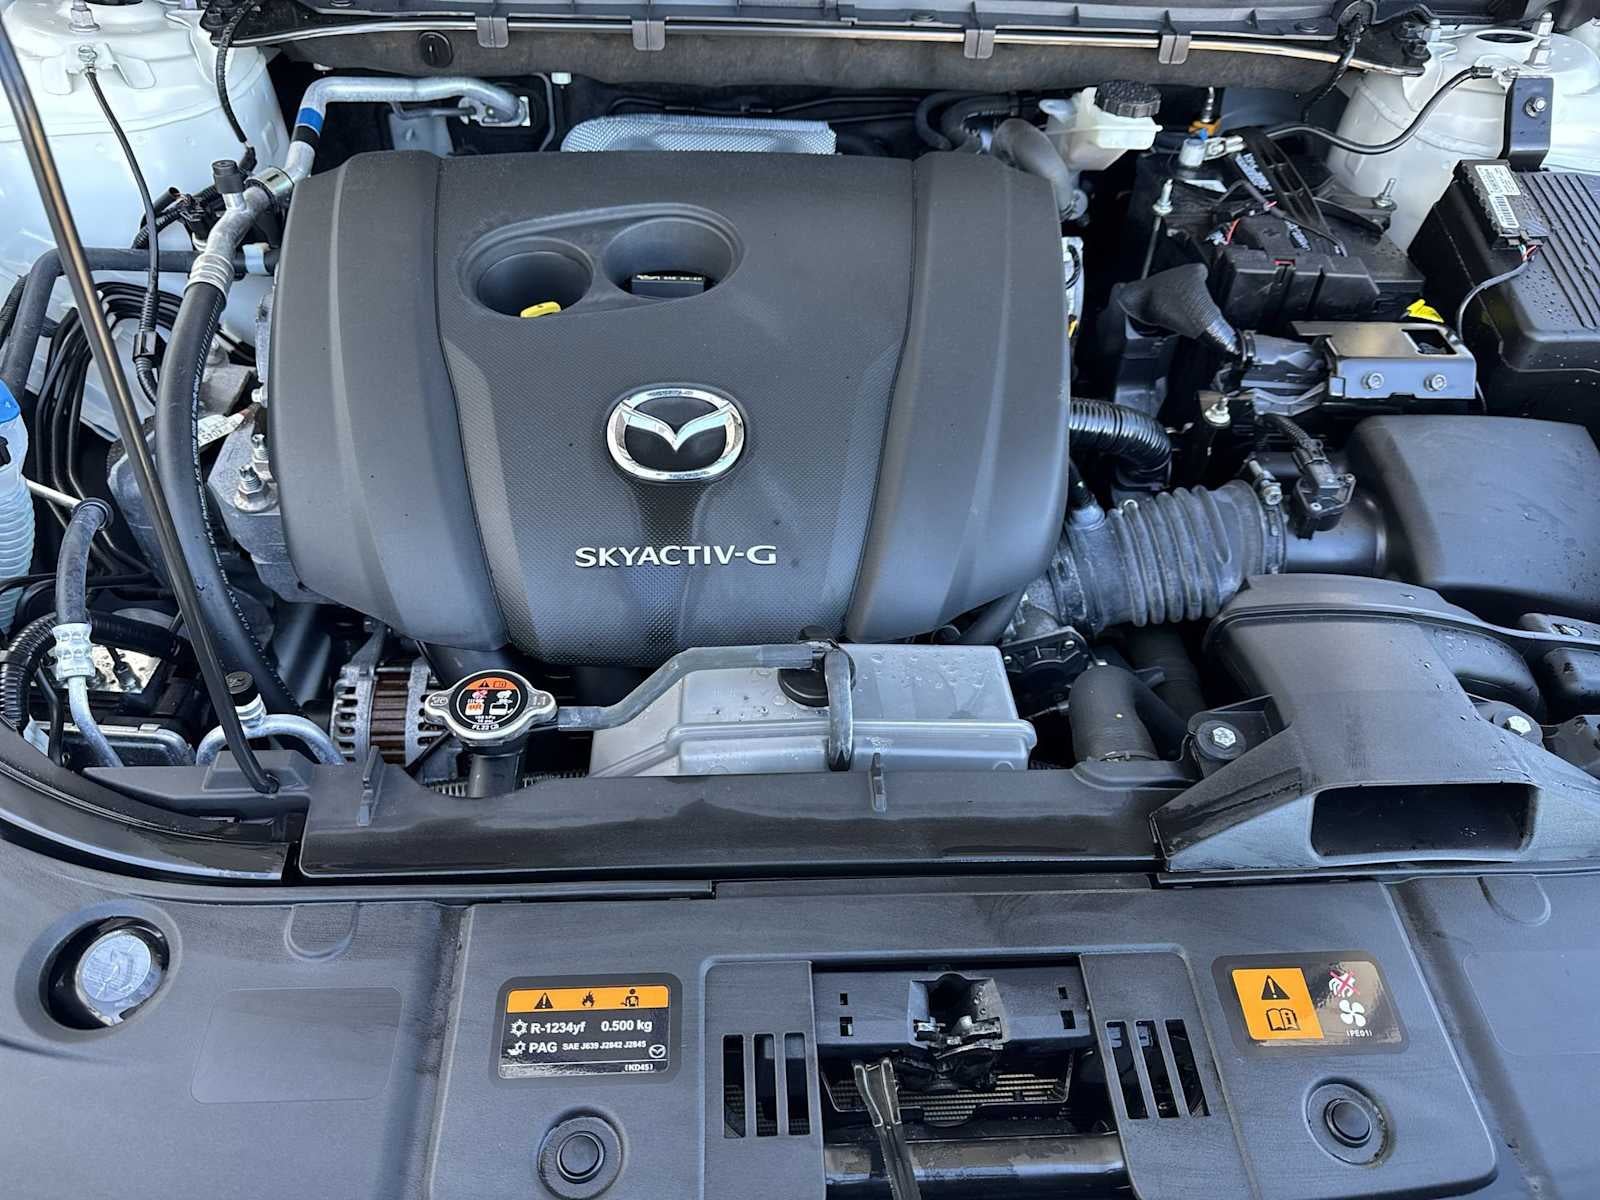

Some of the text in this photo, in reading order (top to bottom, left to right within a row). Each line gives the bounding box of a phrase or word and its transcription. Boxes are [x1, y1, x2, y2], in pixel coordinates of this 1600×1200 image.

[575, 544, 777, 567] SKYACTIV-G
[530, 1019, 653, 1035] R-1234yf 0.500 kg
[529, 1042, 558, 1053] PAG
[562, 1042, 580, 1051] SAE
